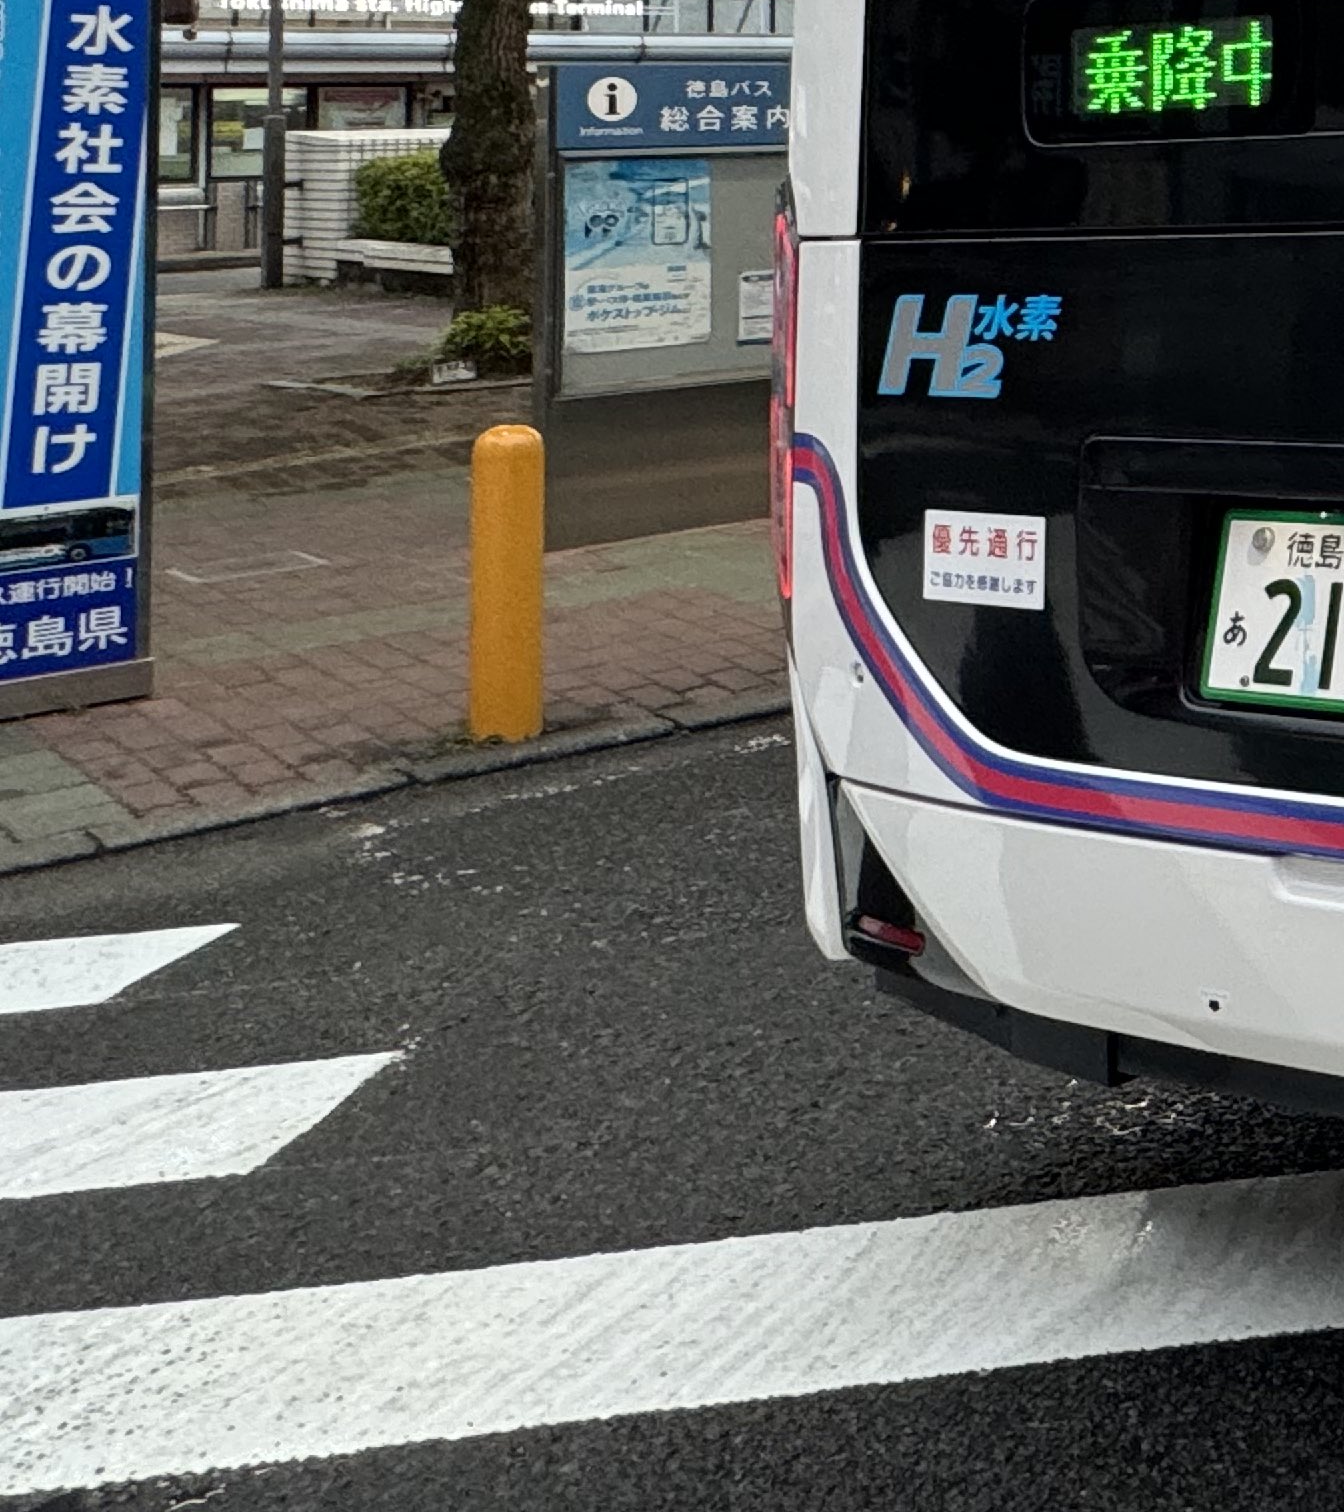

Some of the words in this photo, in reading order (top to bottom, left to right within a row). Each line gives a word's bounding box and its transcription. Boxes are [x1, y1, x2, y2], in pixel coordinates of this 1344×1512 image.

[686, 80, 773, 99] 徳島バス
[659, 104, 790, 132] 総合案内
[31, 4, 135, 475] 水素社会の幕開け
[974, 294, 1063, 341] 水素
[877, 294, 1004, 398] H2
[932, 524, 1038, 562] 優先通行
[1222, 611, 1248, 647] あ
